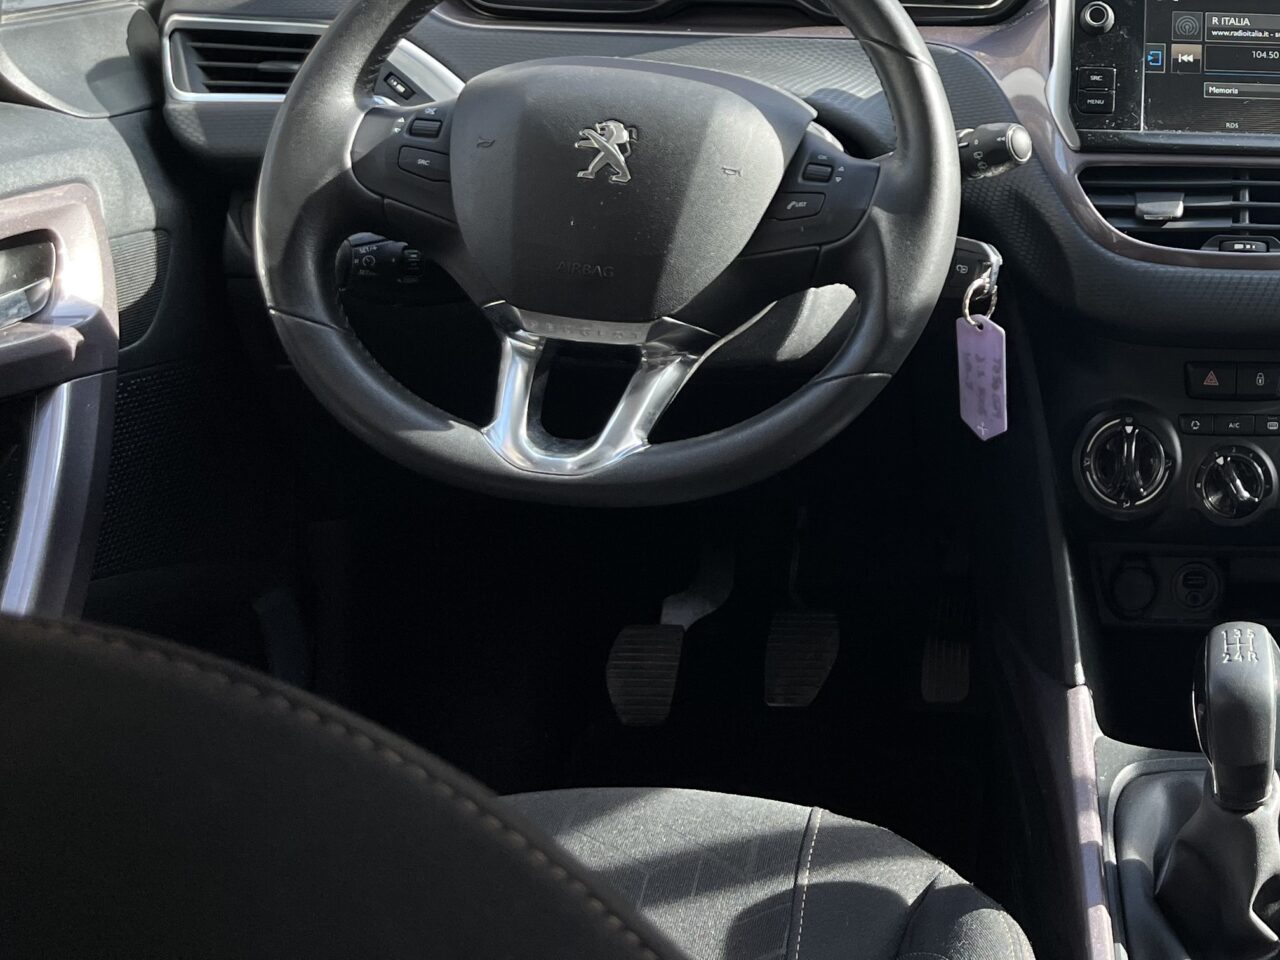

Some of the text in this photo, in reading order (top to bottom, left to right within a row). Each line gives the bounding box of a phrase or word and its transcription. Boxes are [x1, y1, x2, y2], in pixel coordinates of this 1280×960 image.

[1212, 17, 1251, 26] R ITALIA
[1211, 29, 1270, 38] www.radioitalia.it
[1252, 50, 1279, 59] 104.50
[1209, 86, 1238, 94] Memoria
[417, 158, 431, 166] SRC
[556, 260, 617, 279] AIRBAG
[1233, 629, 1242, 638] 3
[1247, 629, 1255, 638] 5
[1222, 651, 1259, 663] 2 4 R
